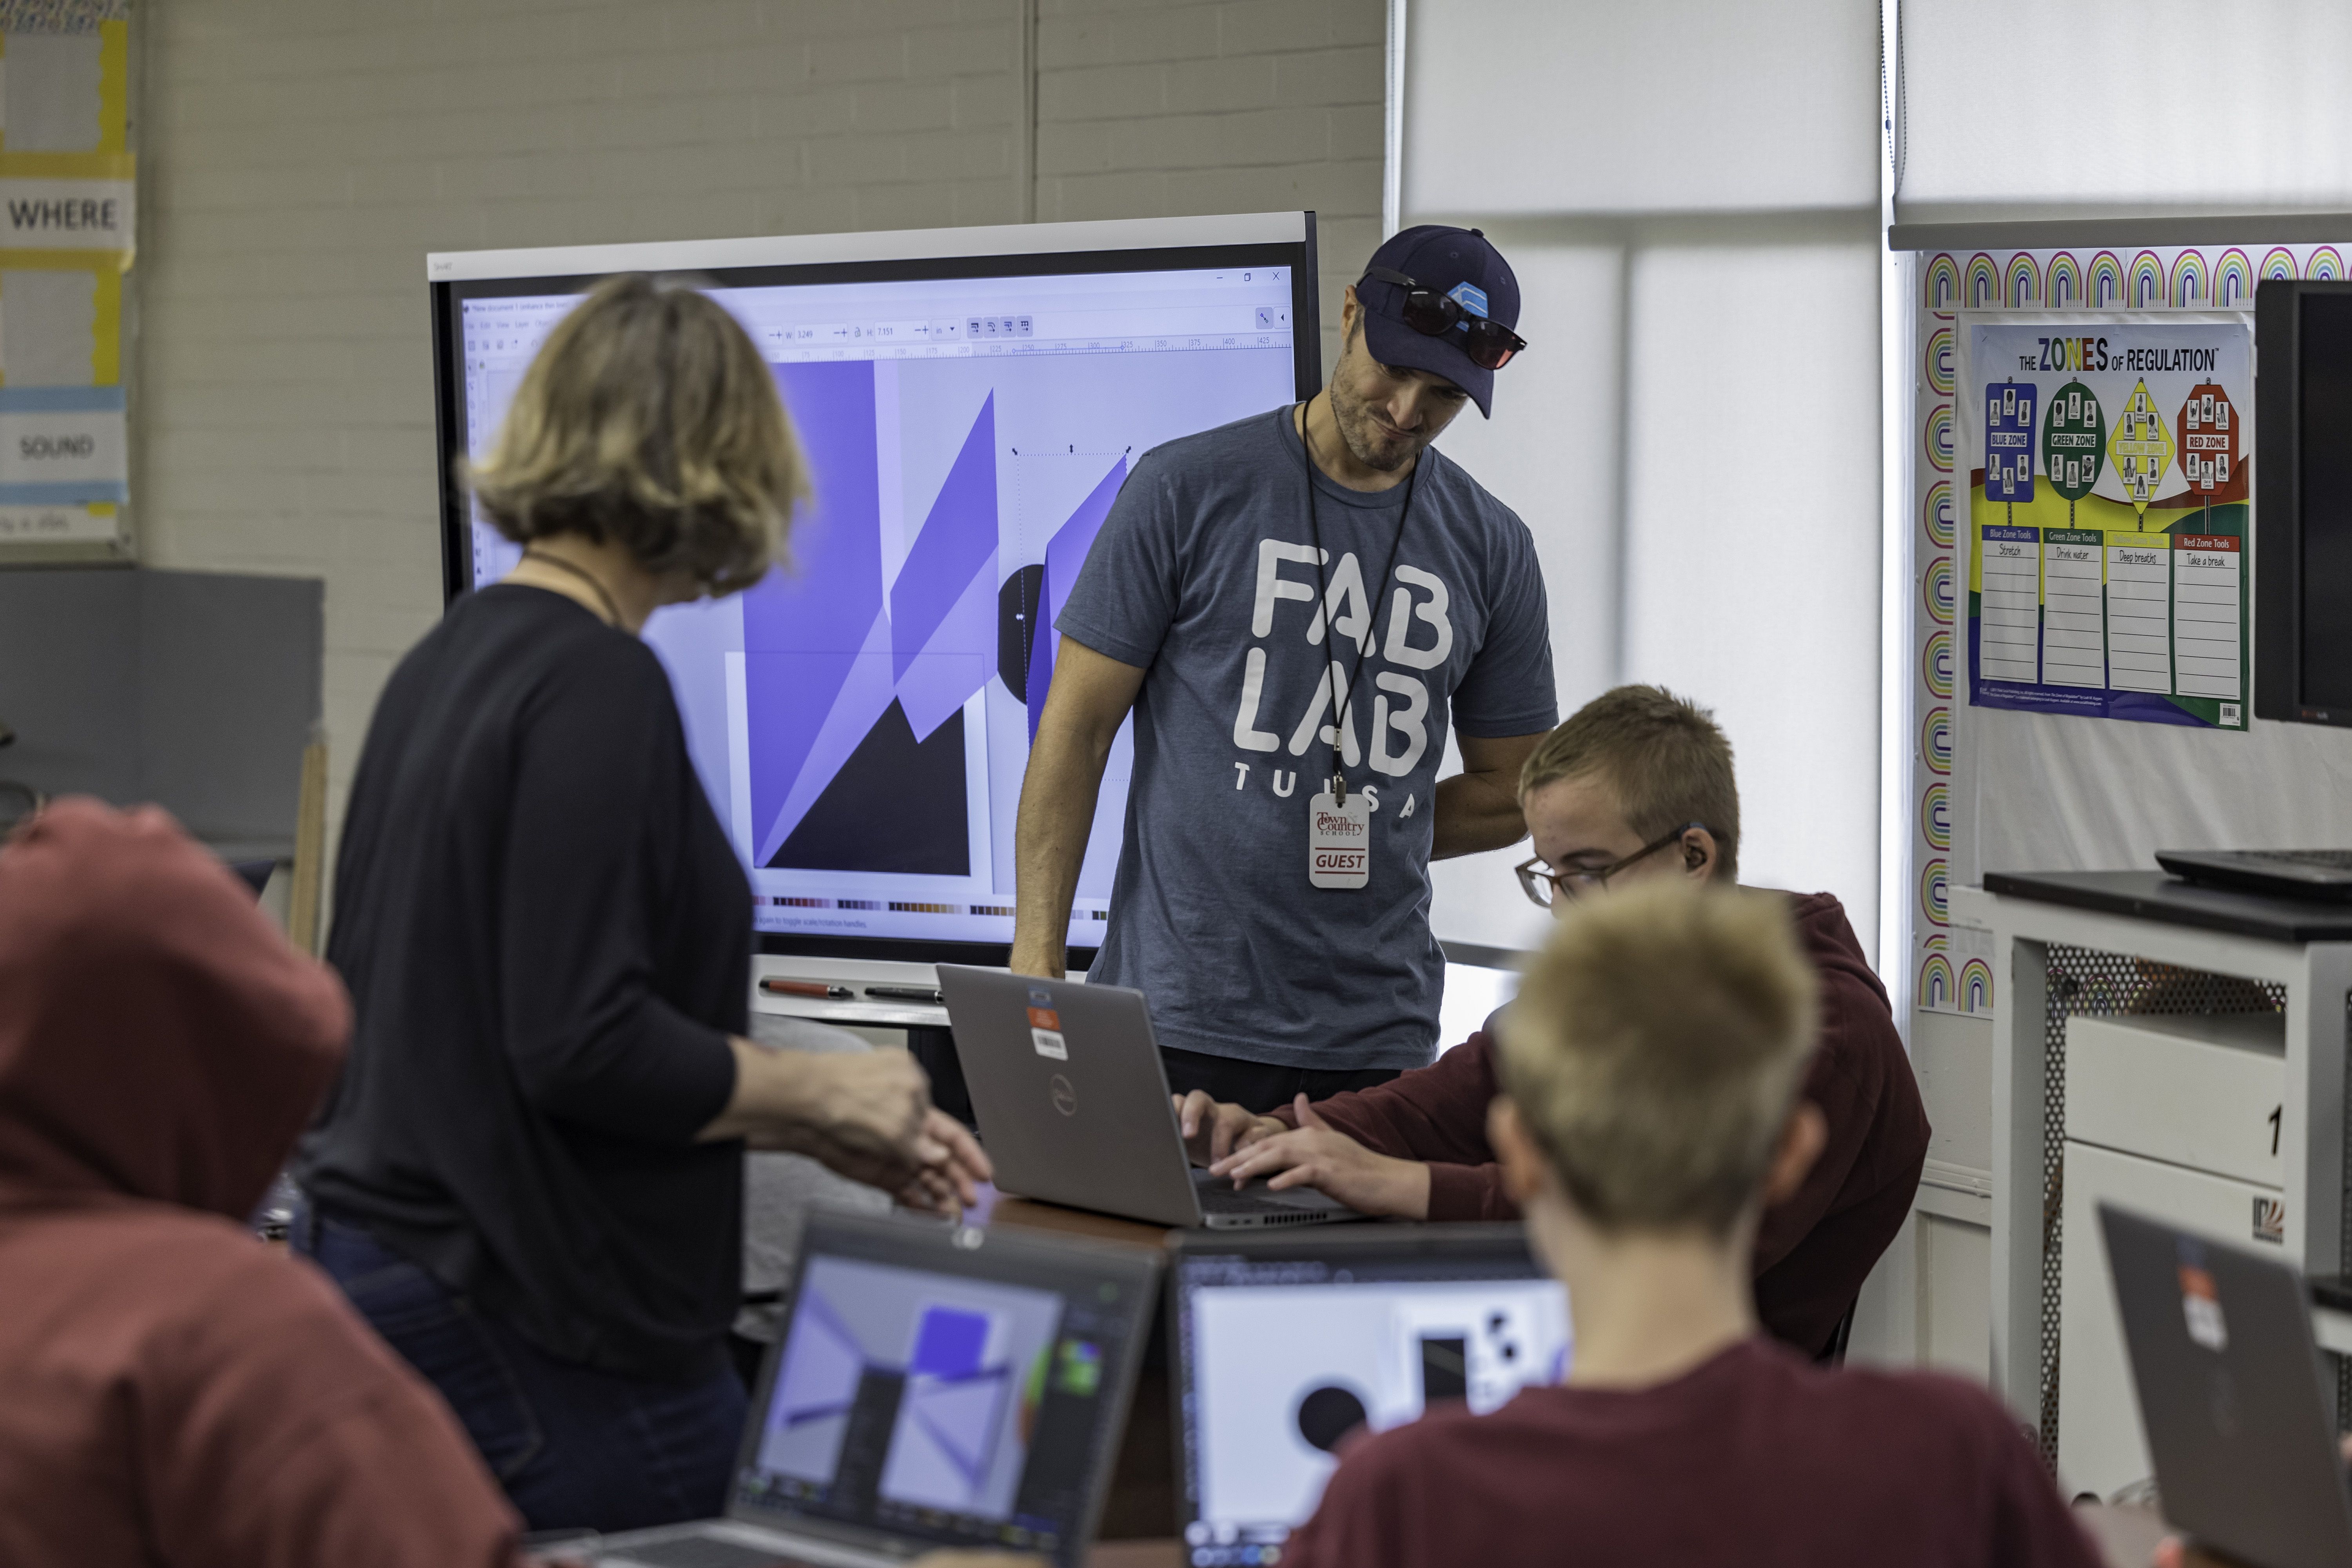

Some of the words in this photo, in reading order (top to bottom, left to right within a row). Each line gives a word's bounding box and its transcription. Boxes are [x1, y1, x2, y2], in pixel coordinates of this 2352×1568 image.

[8, 198, 118, 230] WHERE
[2019, 356, 2036, 370] THE
[2038, 337, 2108, 371] ZONES
[2112, 356, 2124, 371] OF
[1992, 435, 2006, 445] BLUE
[2008, 435, 2025, 445] ZONE
[2053, 435, 2074, 446] GREEN
[2076, 436, 2094, 446] ZONE
[2190, 437, 2203, 447] RED
[2206, 437, 2225, 448] ZONE
[2118, 443, 2145, 454] YELLOW
[2147, 443, 2165, 454] ZONE
[1990, 529, 2002, 537] Blue
[2003, 530, 2016, 538] Zone
[2018, 530, 2031, 539] Tools
[2049, 532, 2065, 541] Green
[2067, 533, 2080, 541] Zone
[2082, 534, 2097, 542] Tools
[2113, 534, 2132, 544] Yellow
[2133, 535, 2147, 544] Zone
[2149, 536, 2164, 545] Tools
[1999, 543, 2021, 556] Stretch
[2184, 538, 2195, 547] Red
[2196, 539, 2212, 548] Zone
[2214, 539, 2229, 548] Tools
[2056, 546, 2072, 559] Drink
[2073, 550, 2089, 560] water
[2120, 550, 2133, 565] Deep
[2134, 552, 2156, 564] breaths
[2187, 553, 2201, 565] Take
[2208, 555, 2225, 566] break
[1252, 539, 1453, 670] FAB
[1234, 647, 1429, 777] LAB
[1316, 812, 1347, 825] Town
[1317, 817, 1365, 835] Country
[1316, 855, 1365, 868] GUEST
[2268, 1103, 2283, 1156] 1
